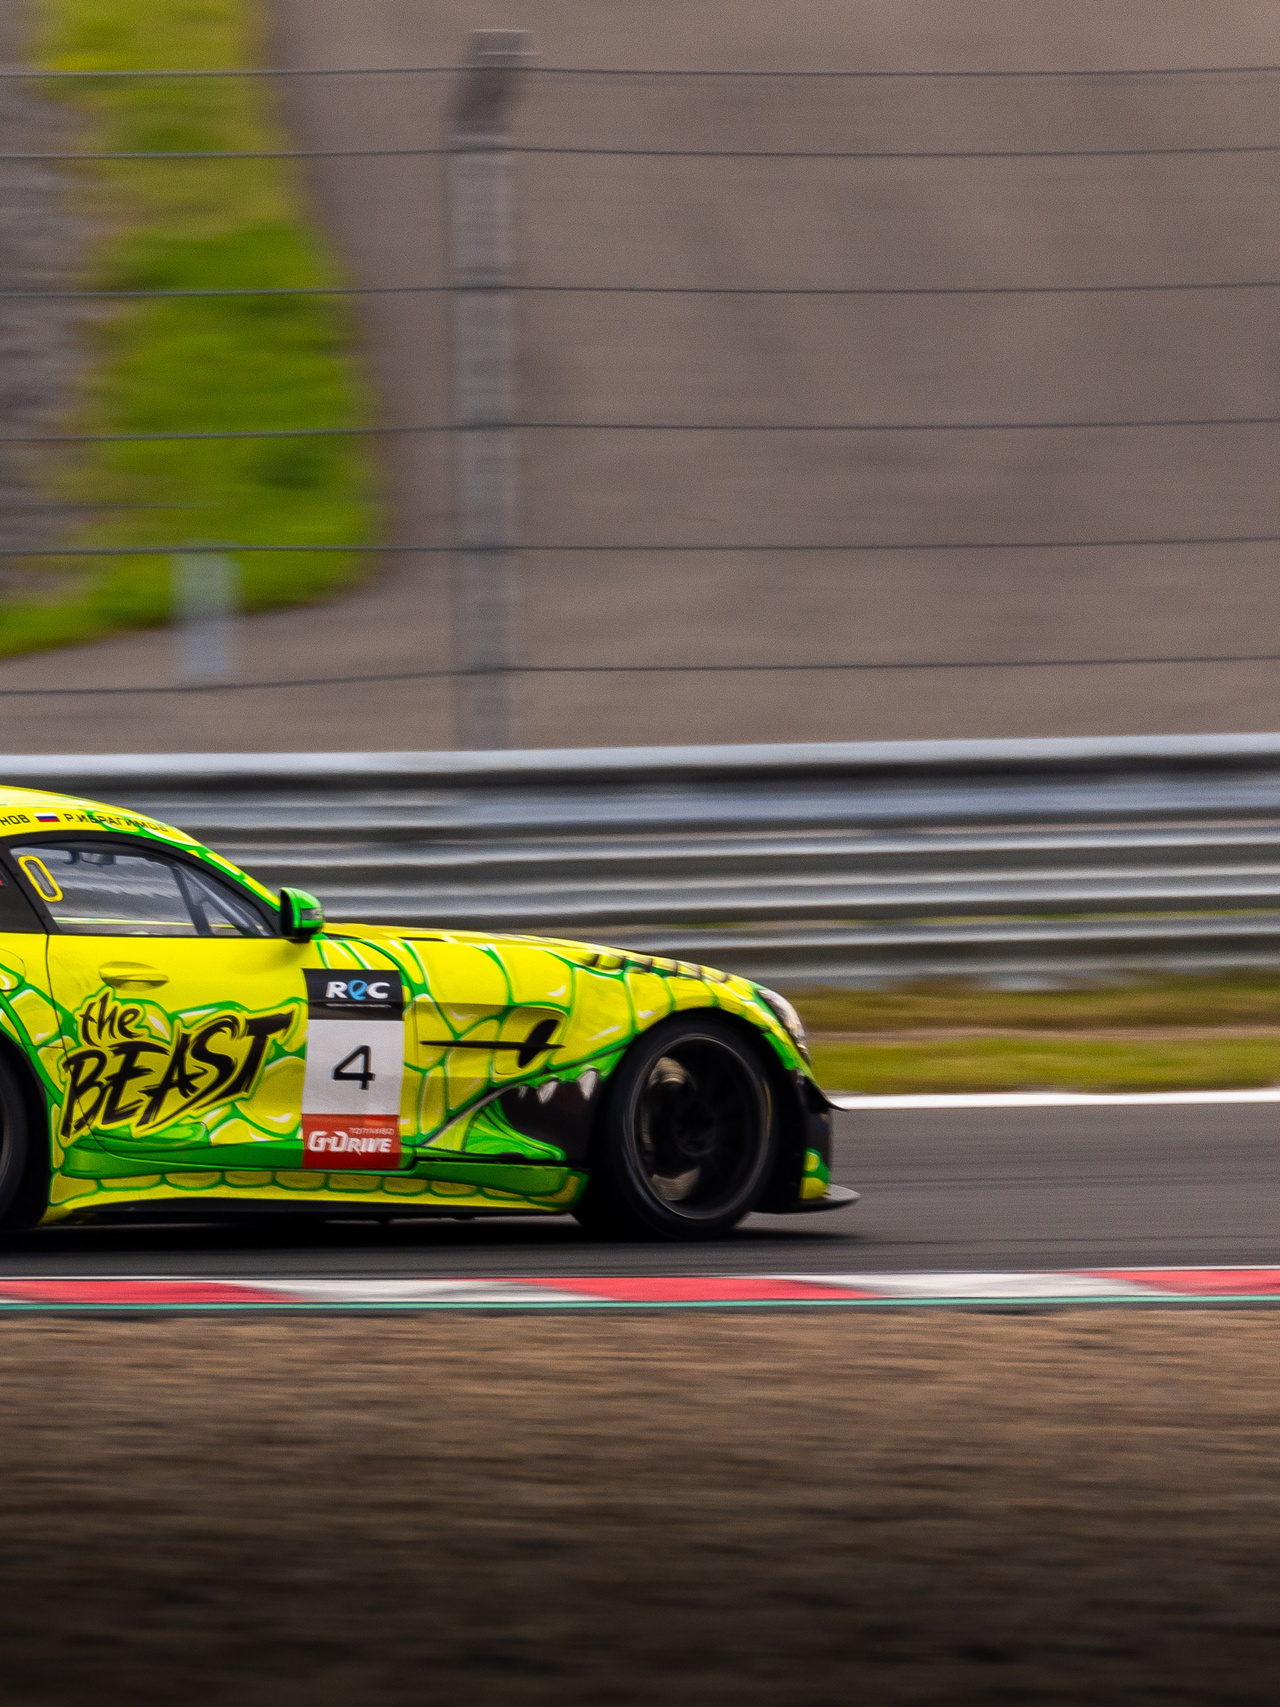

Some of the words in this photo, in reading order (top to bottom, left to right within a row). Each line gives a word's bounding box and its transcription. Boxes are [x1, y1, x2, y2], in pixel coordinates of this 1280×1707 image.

[79, 991, 144, 1048] the
[60, 1009, 296, 1139] BEAST
[332, 1044, 376, 1091] 4
